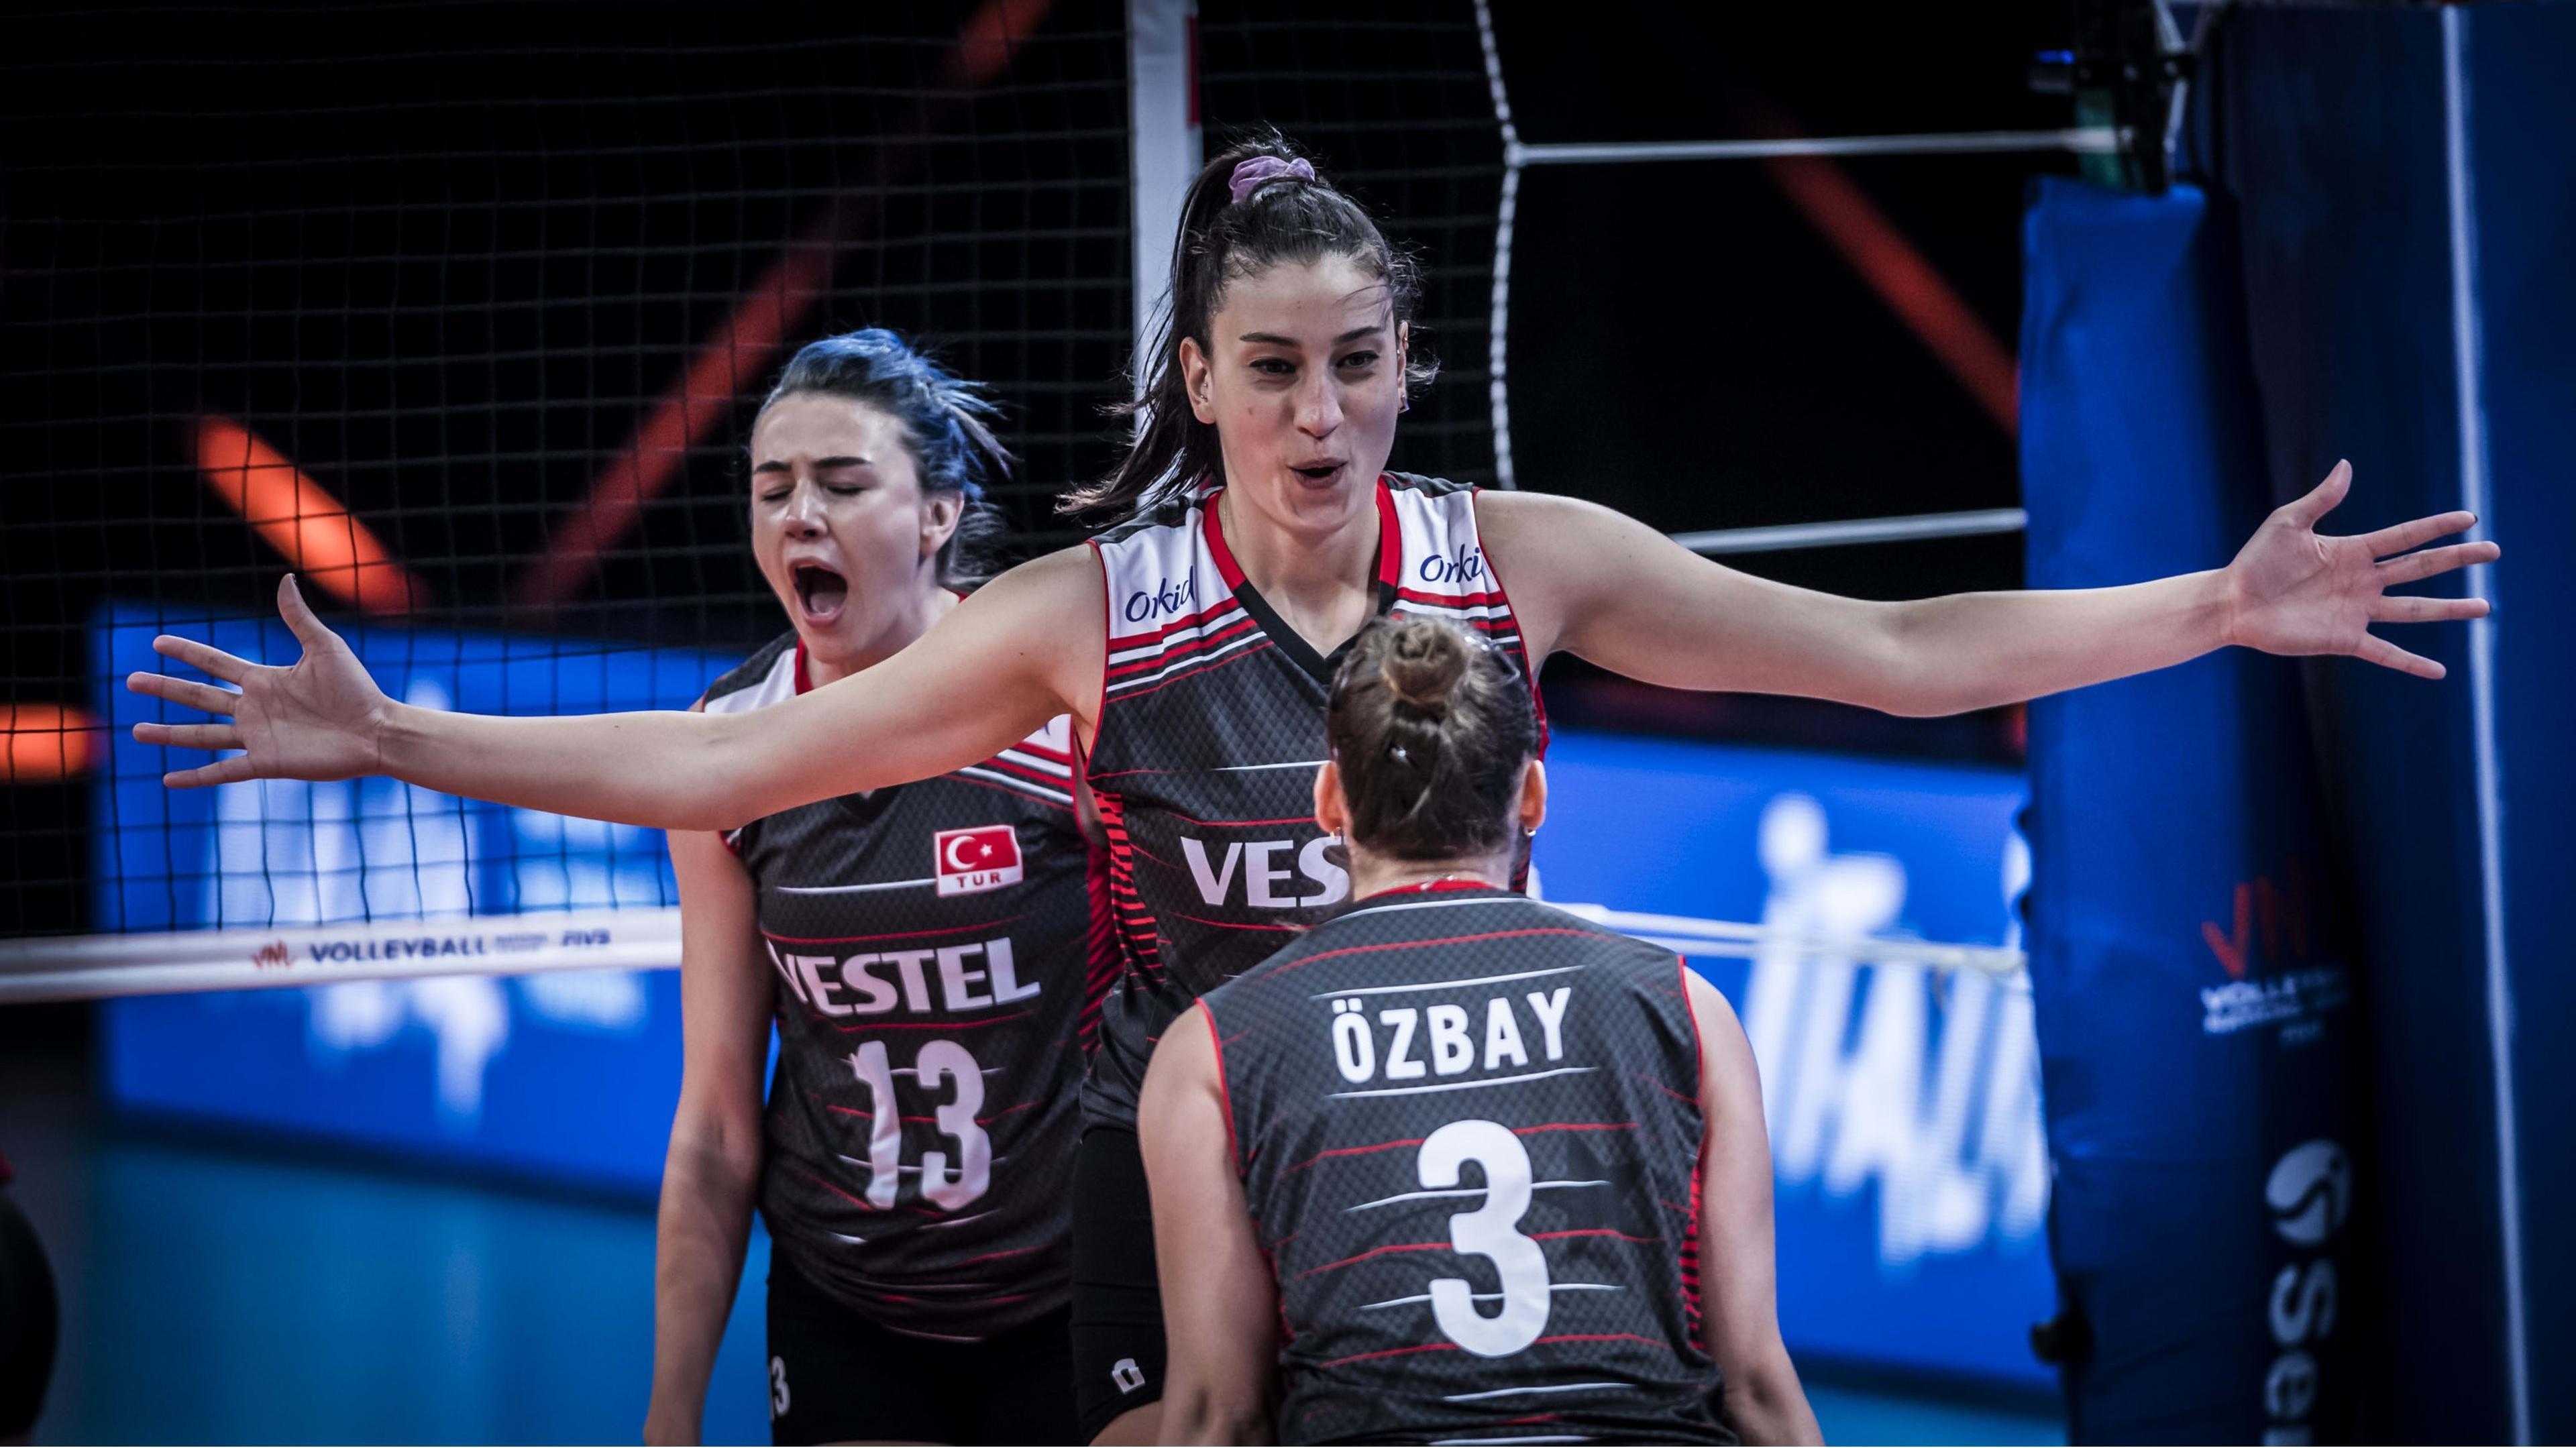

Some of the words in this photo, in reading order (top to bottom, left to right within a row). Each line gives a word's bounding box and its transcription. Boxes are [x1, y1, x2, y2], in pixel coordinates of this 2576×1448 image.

[1125, 565, 1195, 622] Orkid
[1420, 543, 1483, 583] Orki
[957, 872, 1001, 888] TUR
[1180, 836, 1351, 908] VES
[309, 938, 487, 963] VOLLEYBALL
[766, 937, 1041, 1017] VESTEL
[1332, 987, 1572, 1083] ÖZBAY
[849, 1039, 992, 1211] 13
[1417, 1119, 1551, 1357] 3
[767, 1355, 791, 1421] 3
